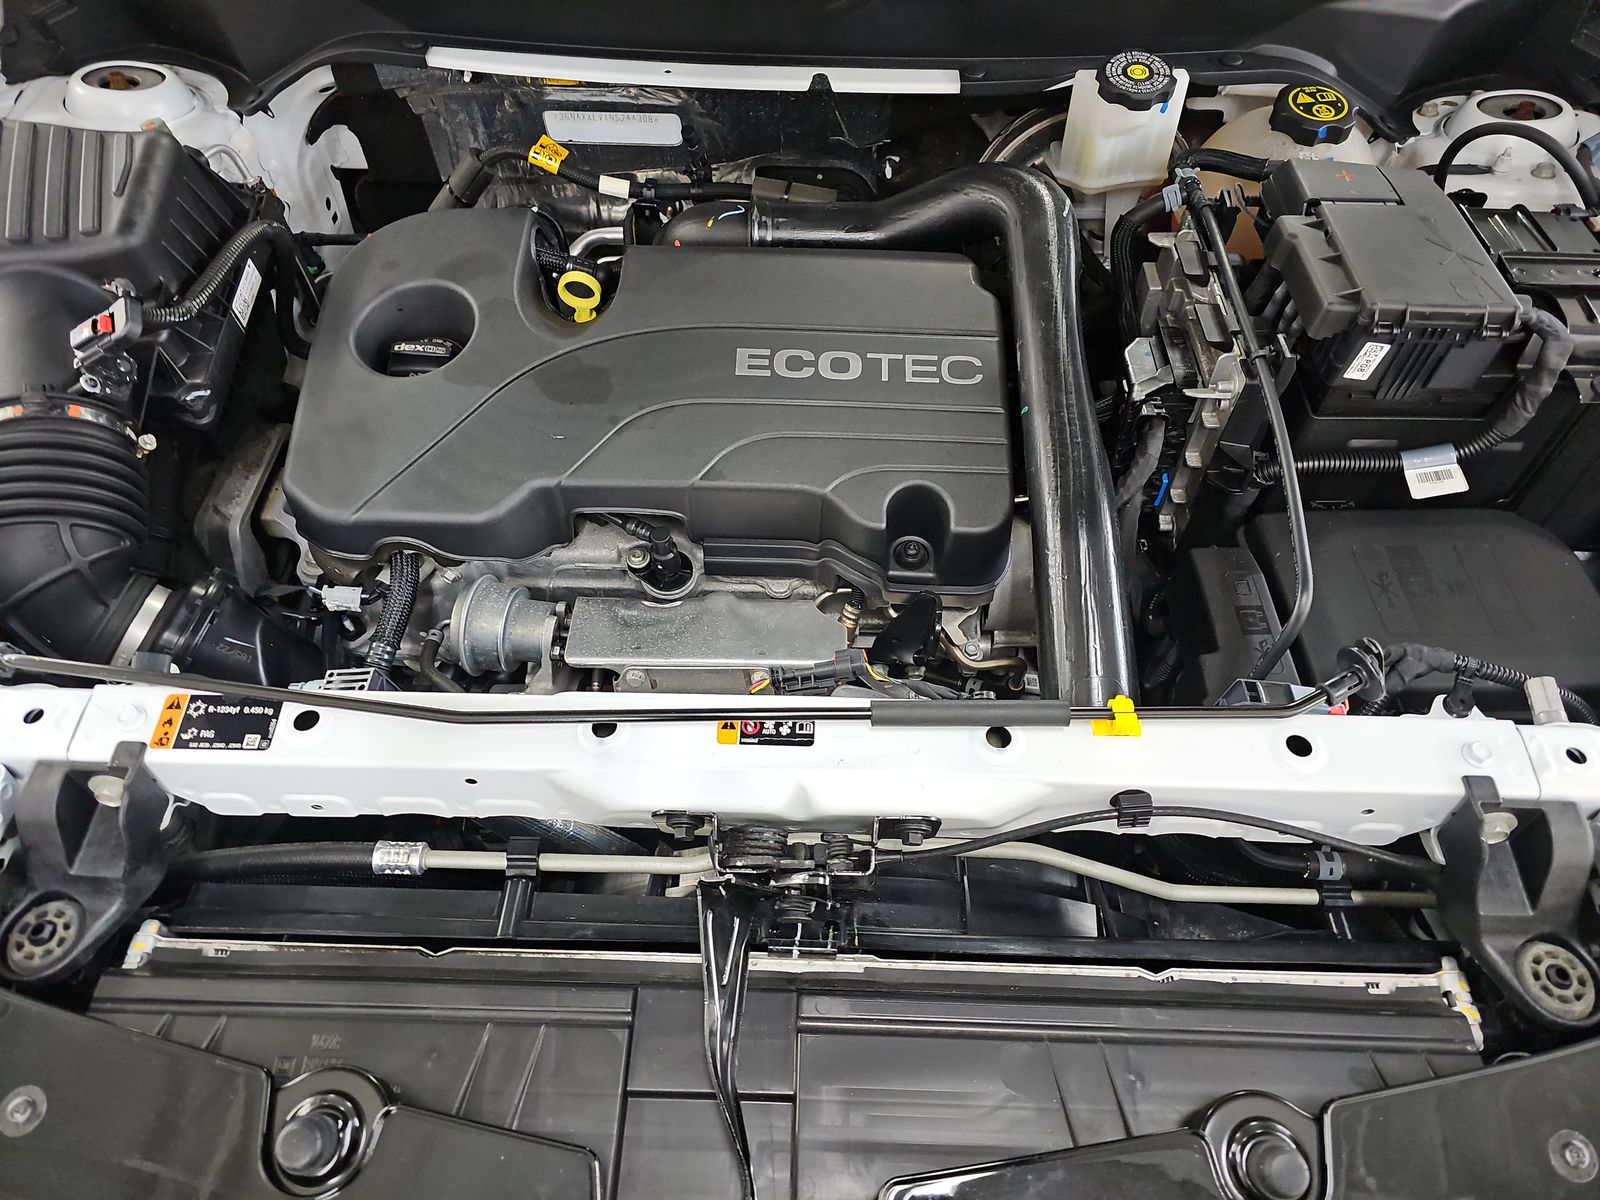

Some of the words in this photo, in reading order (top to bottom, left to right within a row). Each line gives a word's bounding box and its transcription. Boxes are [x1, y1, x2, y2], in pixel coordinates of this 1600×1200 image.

[735, 348, 983, 385] ECOTEC
[243, 706, 263, 714] 0.450
[264, 707, 274, 716] kg
[200, 729, 215, 738] PAG
